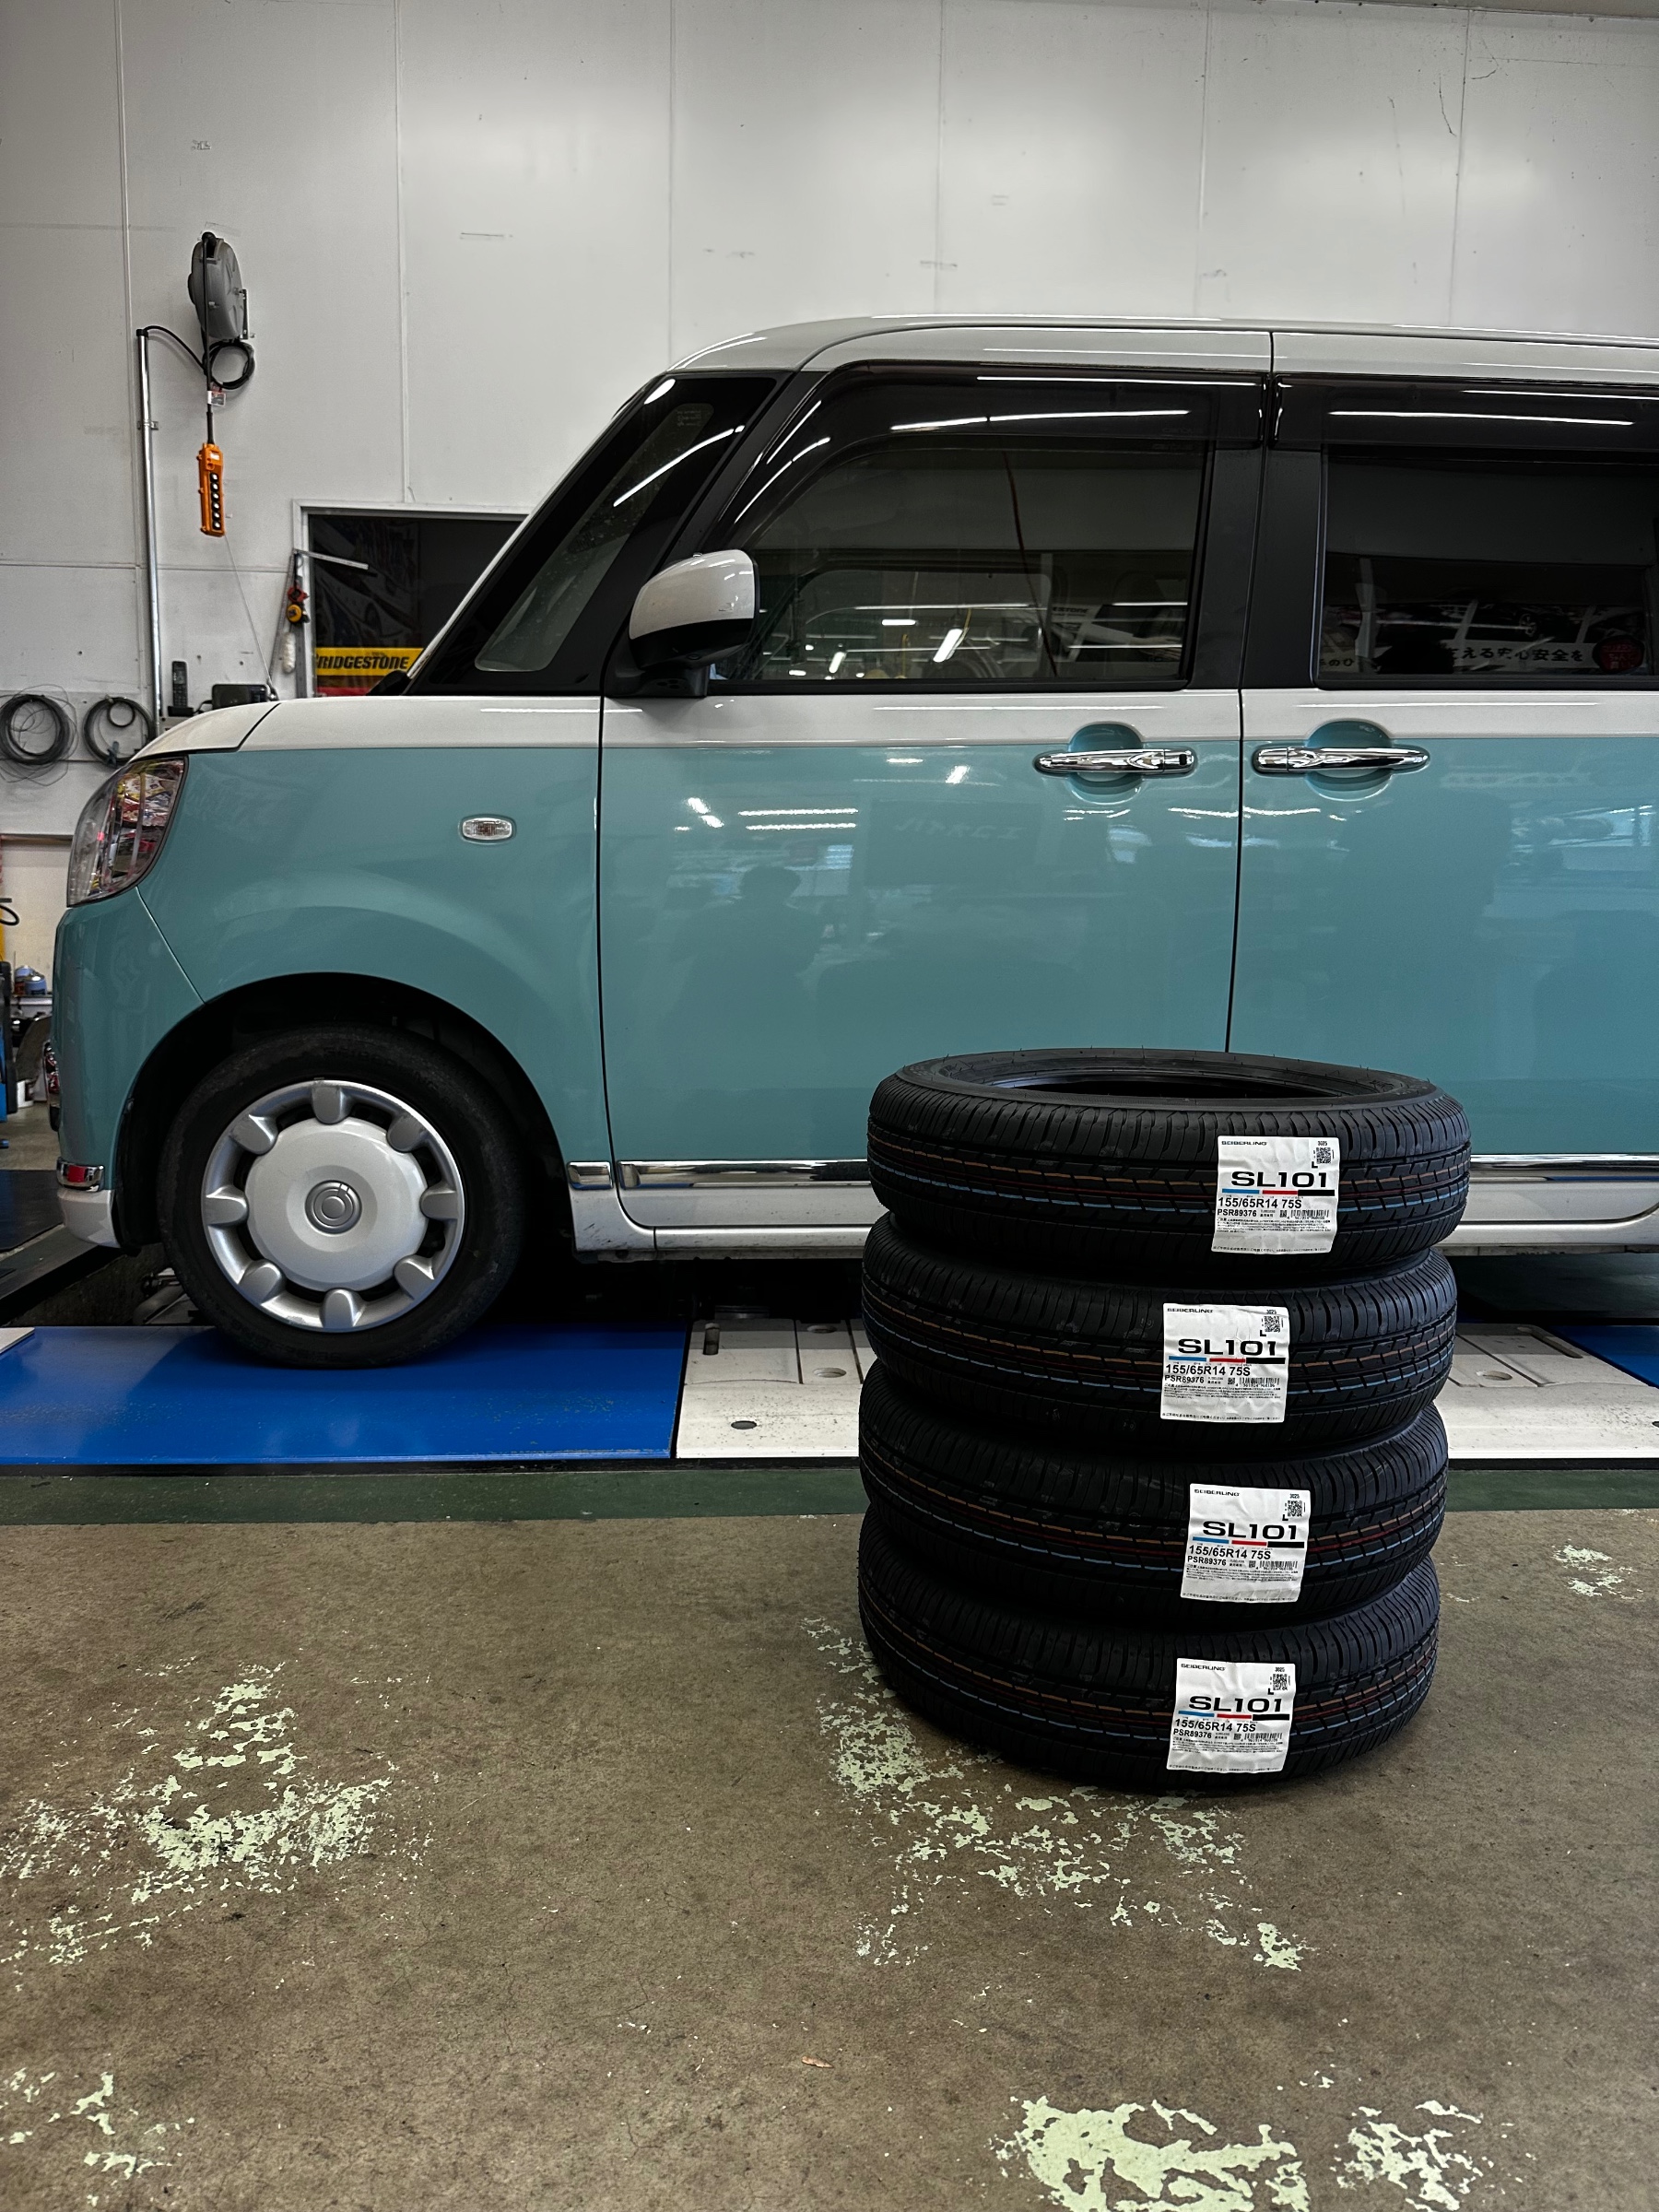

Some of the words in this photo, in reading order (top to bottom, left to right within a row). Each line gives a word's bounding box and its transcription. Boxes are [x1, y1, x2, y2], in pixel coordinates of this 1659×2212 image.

[316, 654, 411, 670] RIDGESTONE
[1231, 1171, 1327, 1187] SL101
[1217, 1197, 1279, 1209] 155/65R14
[1281, 1198, 1303, 1209] 75S
[1217, 1208, 1257, 1218] PSR89376
[1178, 1339, 1277, 1356] SL101
[1165, 1364, 1227, 1376] 155/65R14
[1229, 1366, 1252, 1377] 75S
[1203, 1521, 1298, 1540] SL101
[1189, 1546, 1248, 1559] 155/65R14
[1250, 1549, 1272, 1560] 75S
[1187, 1556, 1228, 1567] PSR89376
[1189, 1696, 1283, 1712] SL101
[1175, 1719, 1233, 1733] 155/65R14
[1235, 1723, 1257, 1733] 75S
[1173, 1729, 1213, 1739] PSR89376
